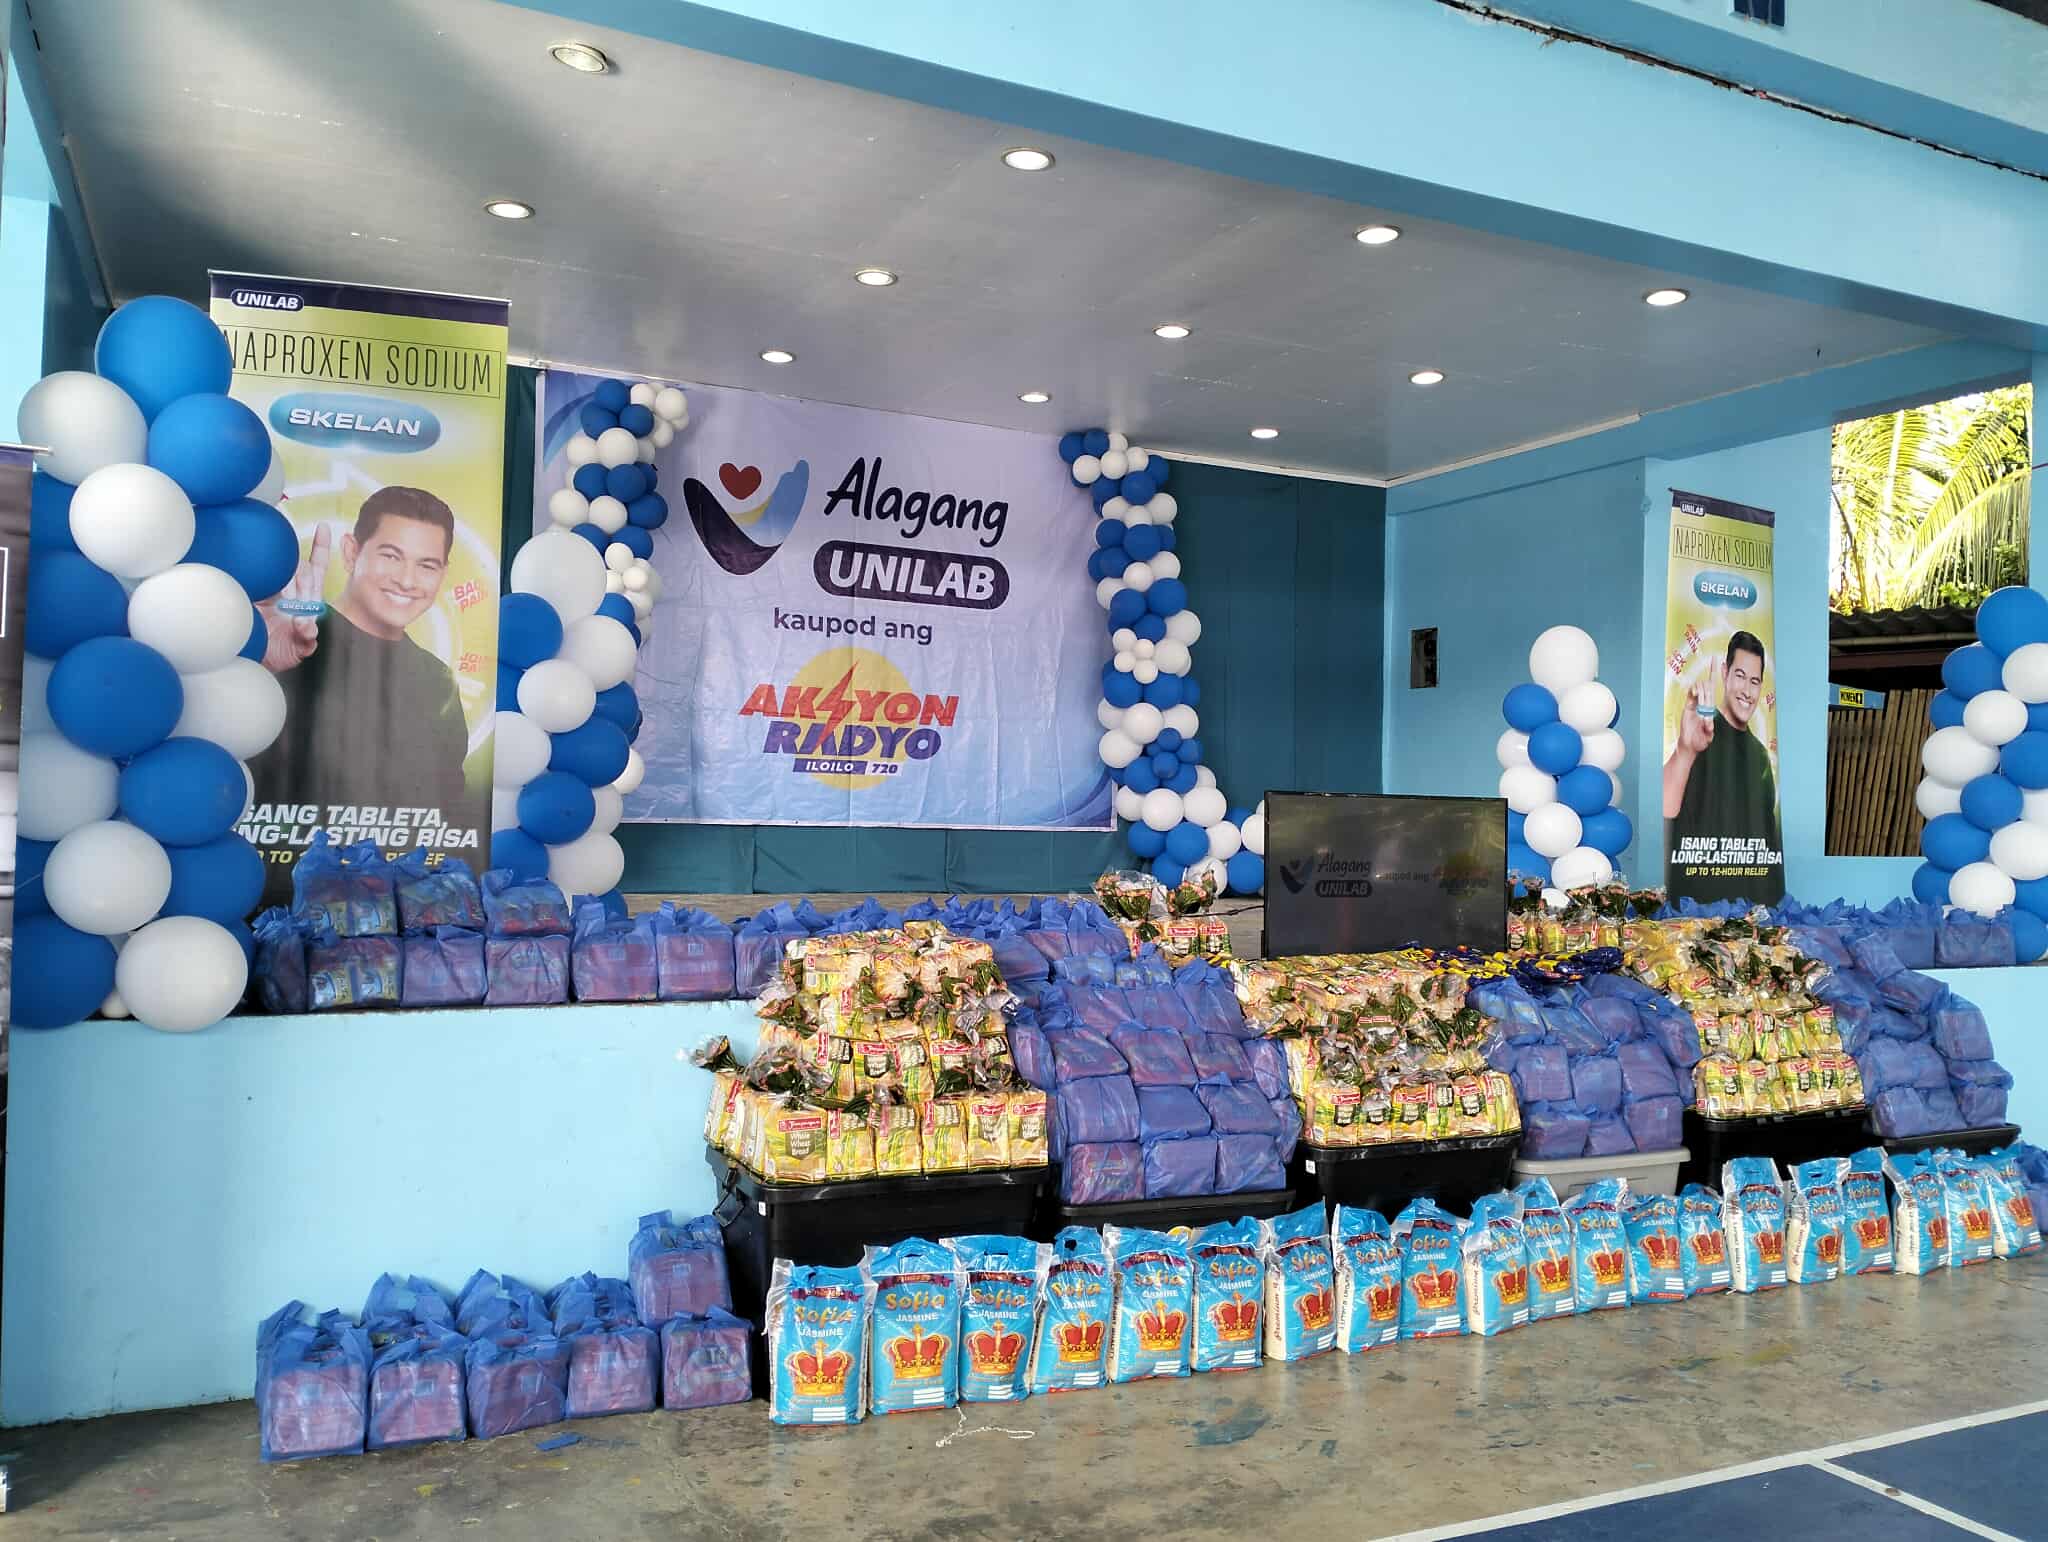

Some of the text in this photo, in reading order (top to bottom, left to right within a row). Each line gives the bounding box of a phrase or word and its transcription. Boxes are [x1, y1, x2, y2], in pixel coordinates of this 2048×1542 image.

[237, 292, 299, 310] UNILAB
[386, 344, 493, 393] SODIUM
[287, 406, 422, 438] SKELAN
[823, 456, 1009, 548] Alagang
[1681, 503, 1704, 516] UNILAB
[1674, 527, 1773, 569] NAPROXEN SODIUM
[828, 549, 996, 601] UNILAB
[1700, 581, 1749, 599] SKELAN
[773, 608, 933, 645] kaupod ang
[762, 720, 942, 761] RADYO
[804, 760, 899, 774] ILOILO 720
[326, 805, 449, 829] TABLETA,
[1680, 837, 1770, 853] ISANG TABLETA,
[269, 850, 293, 864] TO
[1317, 852, 1371, 878] Alagang
[1671, 849, 1756, 865] LONG-LASTING
[1685, 866, 1769, 877] UP TO 12-HOUR RELIEF
[1319, 880, 1369, 896] UNILAB
[885, 1291, 946, 1312] Sofia
[970, 1288, 1026, 1309] Sofia
[895, 1312, 939, 1322] JASMINE
[799, 1327, 844, 1338] JASMINE
